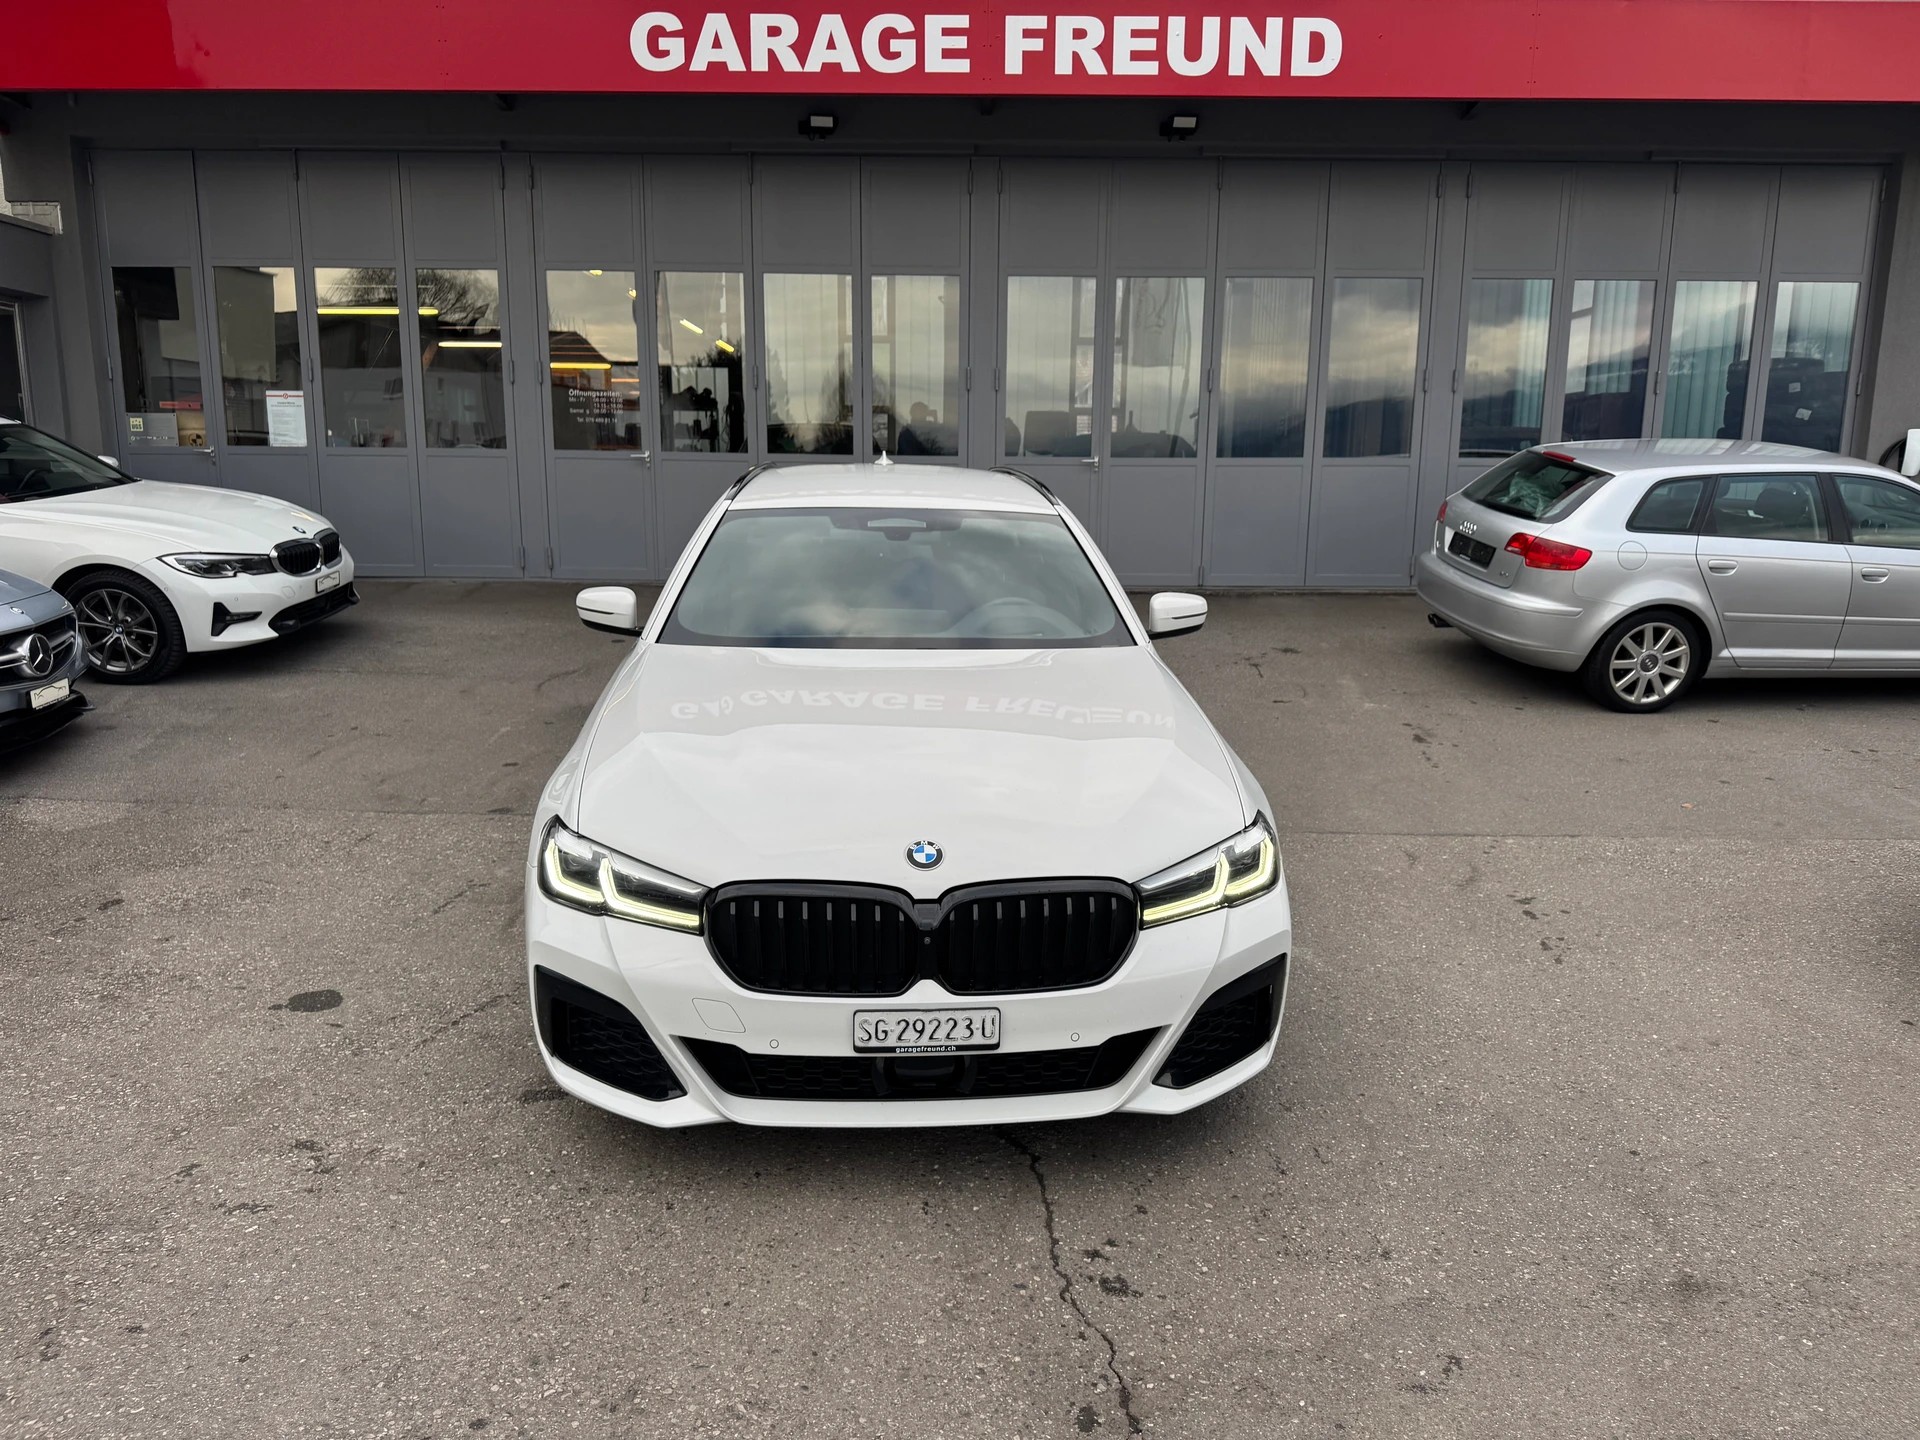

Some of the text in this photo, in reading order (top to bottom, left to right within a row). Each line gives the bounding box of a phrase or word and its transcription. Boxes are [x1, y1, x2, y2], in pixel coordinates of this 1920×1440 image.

[629, 11, 1343, 78] GARAGE FREUND
[568, 388, 623, 398] Öffnungszeiten:
[895, 1045, 957, 1054] garagefreund.ch
